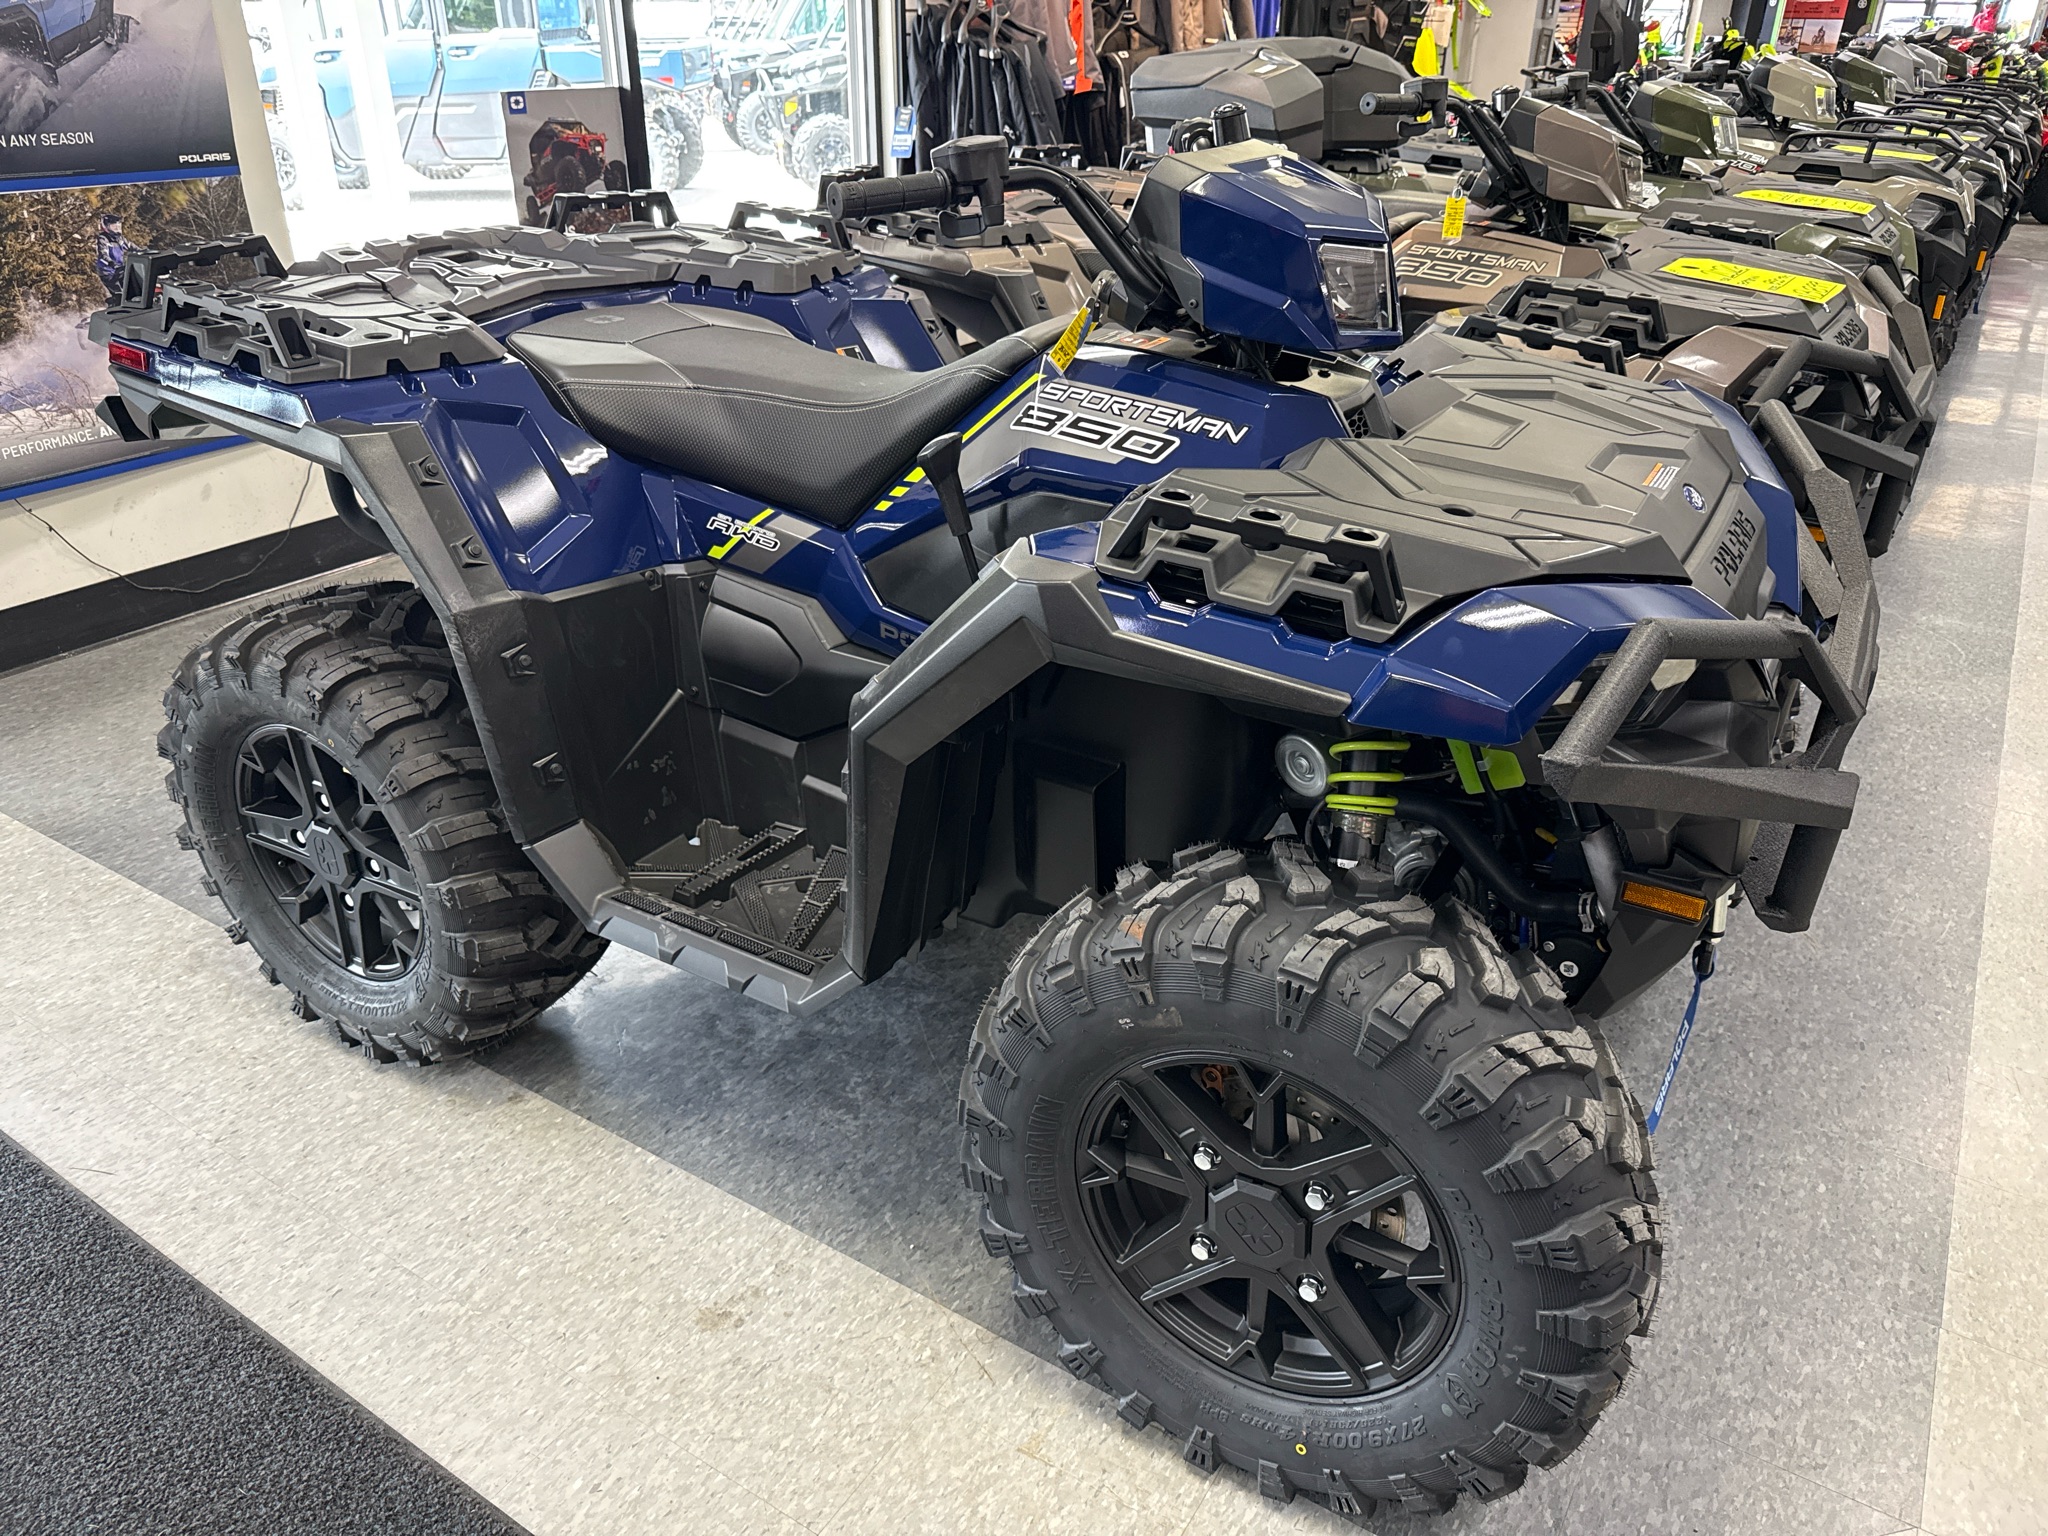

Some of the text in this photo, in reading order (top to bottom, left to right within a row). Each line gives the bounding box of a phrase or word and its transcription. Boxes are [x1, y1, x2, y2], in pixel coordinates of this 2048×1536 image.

[10, 133, 37, 147] ANY
[41, 131, 94, 146] SEASON
[179, 152, 231, 163] POLARIS
[1395, 256, 1503, 288] 850
[1407, 244, 1548, 274] SPORTSMAN
[1010, 401, 1181, 465] 850
[1038, 381, 1250, 445] SPORTSMAN
[2, 430, 98, 460] PERFORMANCE.
[707, 516, 780, 551] AWD
[1710, 509, 1757, 587] POLARIS
[1654, 1019, 1690, 1117] POLARIS
[1024, 1094, 1096, 1295] X-TERRAIN
[1461, 1272, 1504, 1388] ARMOR
